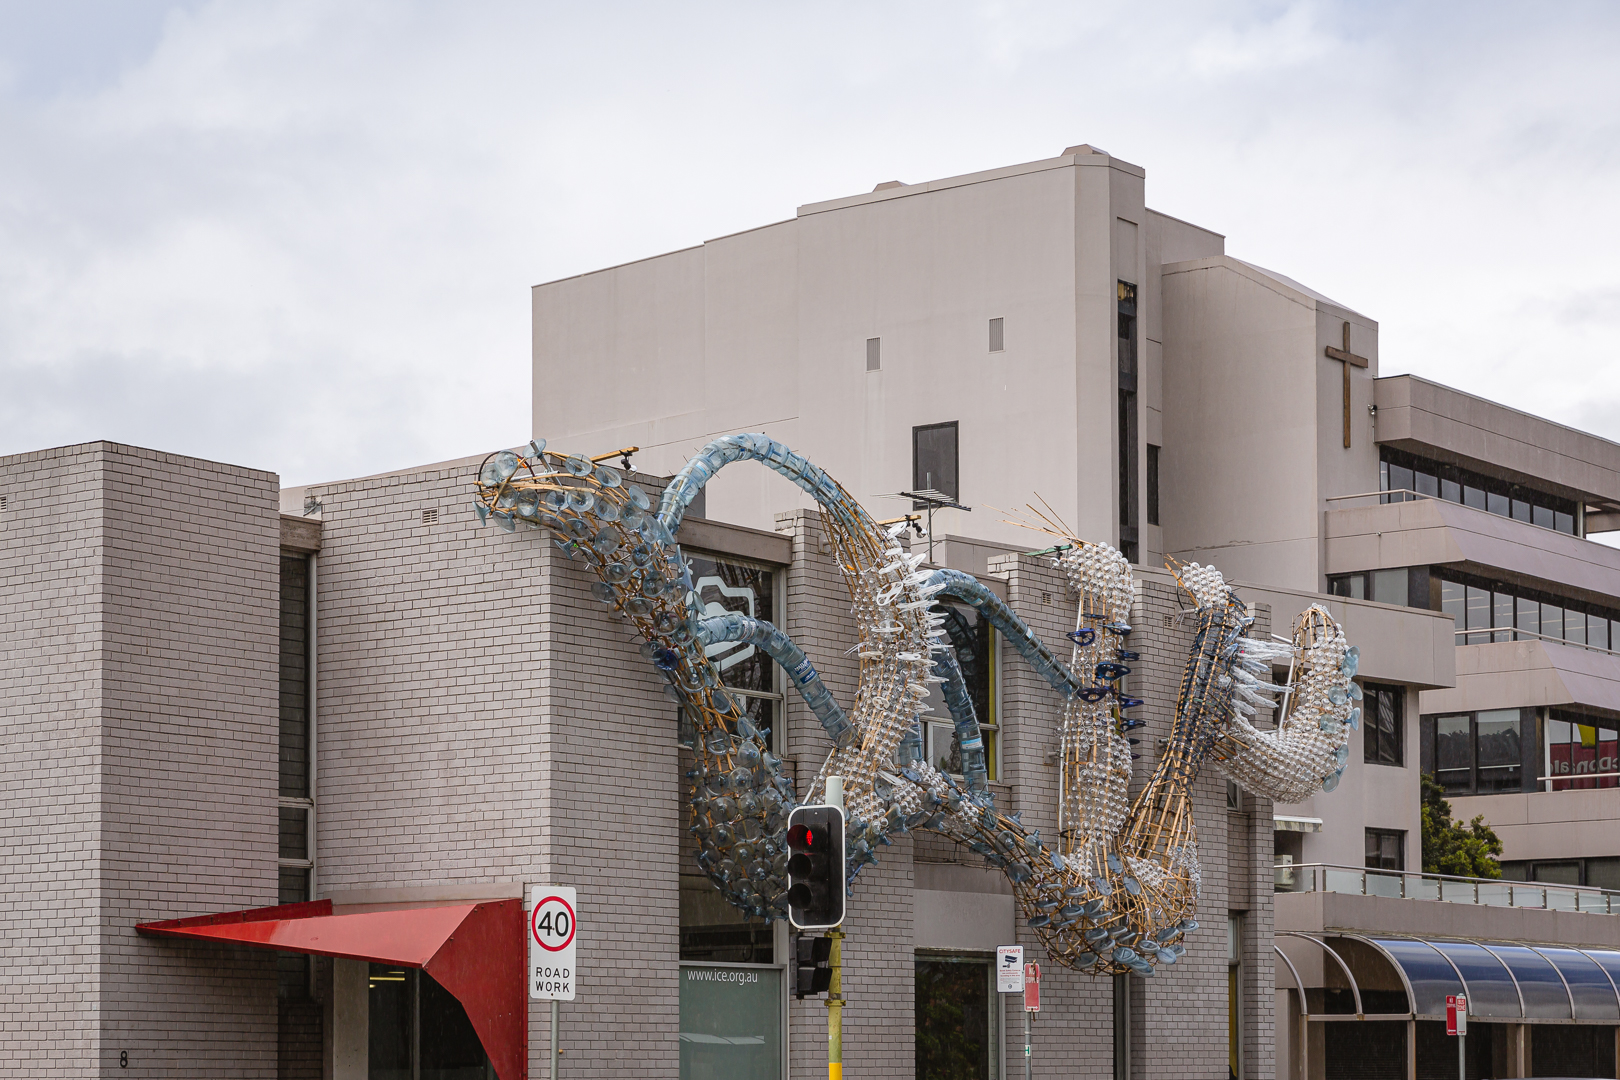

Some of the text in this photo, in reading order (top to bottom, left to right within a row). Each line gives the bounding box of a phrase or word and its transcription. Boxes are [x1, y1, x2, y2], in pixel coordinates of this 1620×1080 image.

[537, 911, 569, 937] 40
[535, 966, 570, 979] ROAD
[687, 968, 758, 986] www.ice.org.au
[535, 980, 570, 993] WORK
[120, 1050, 128, 1068] 8
